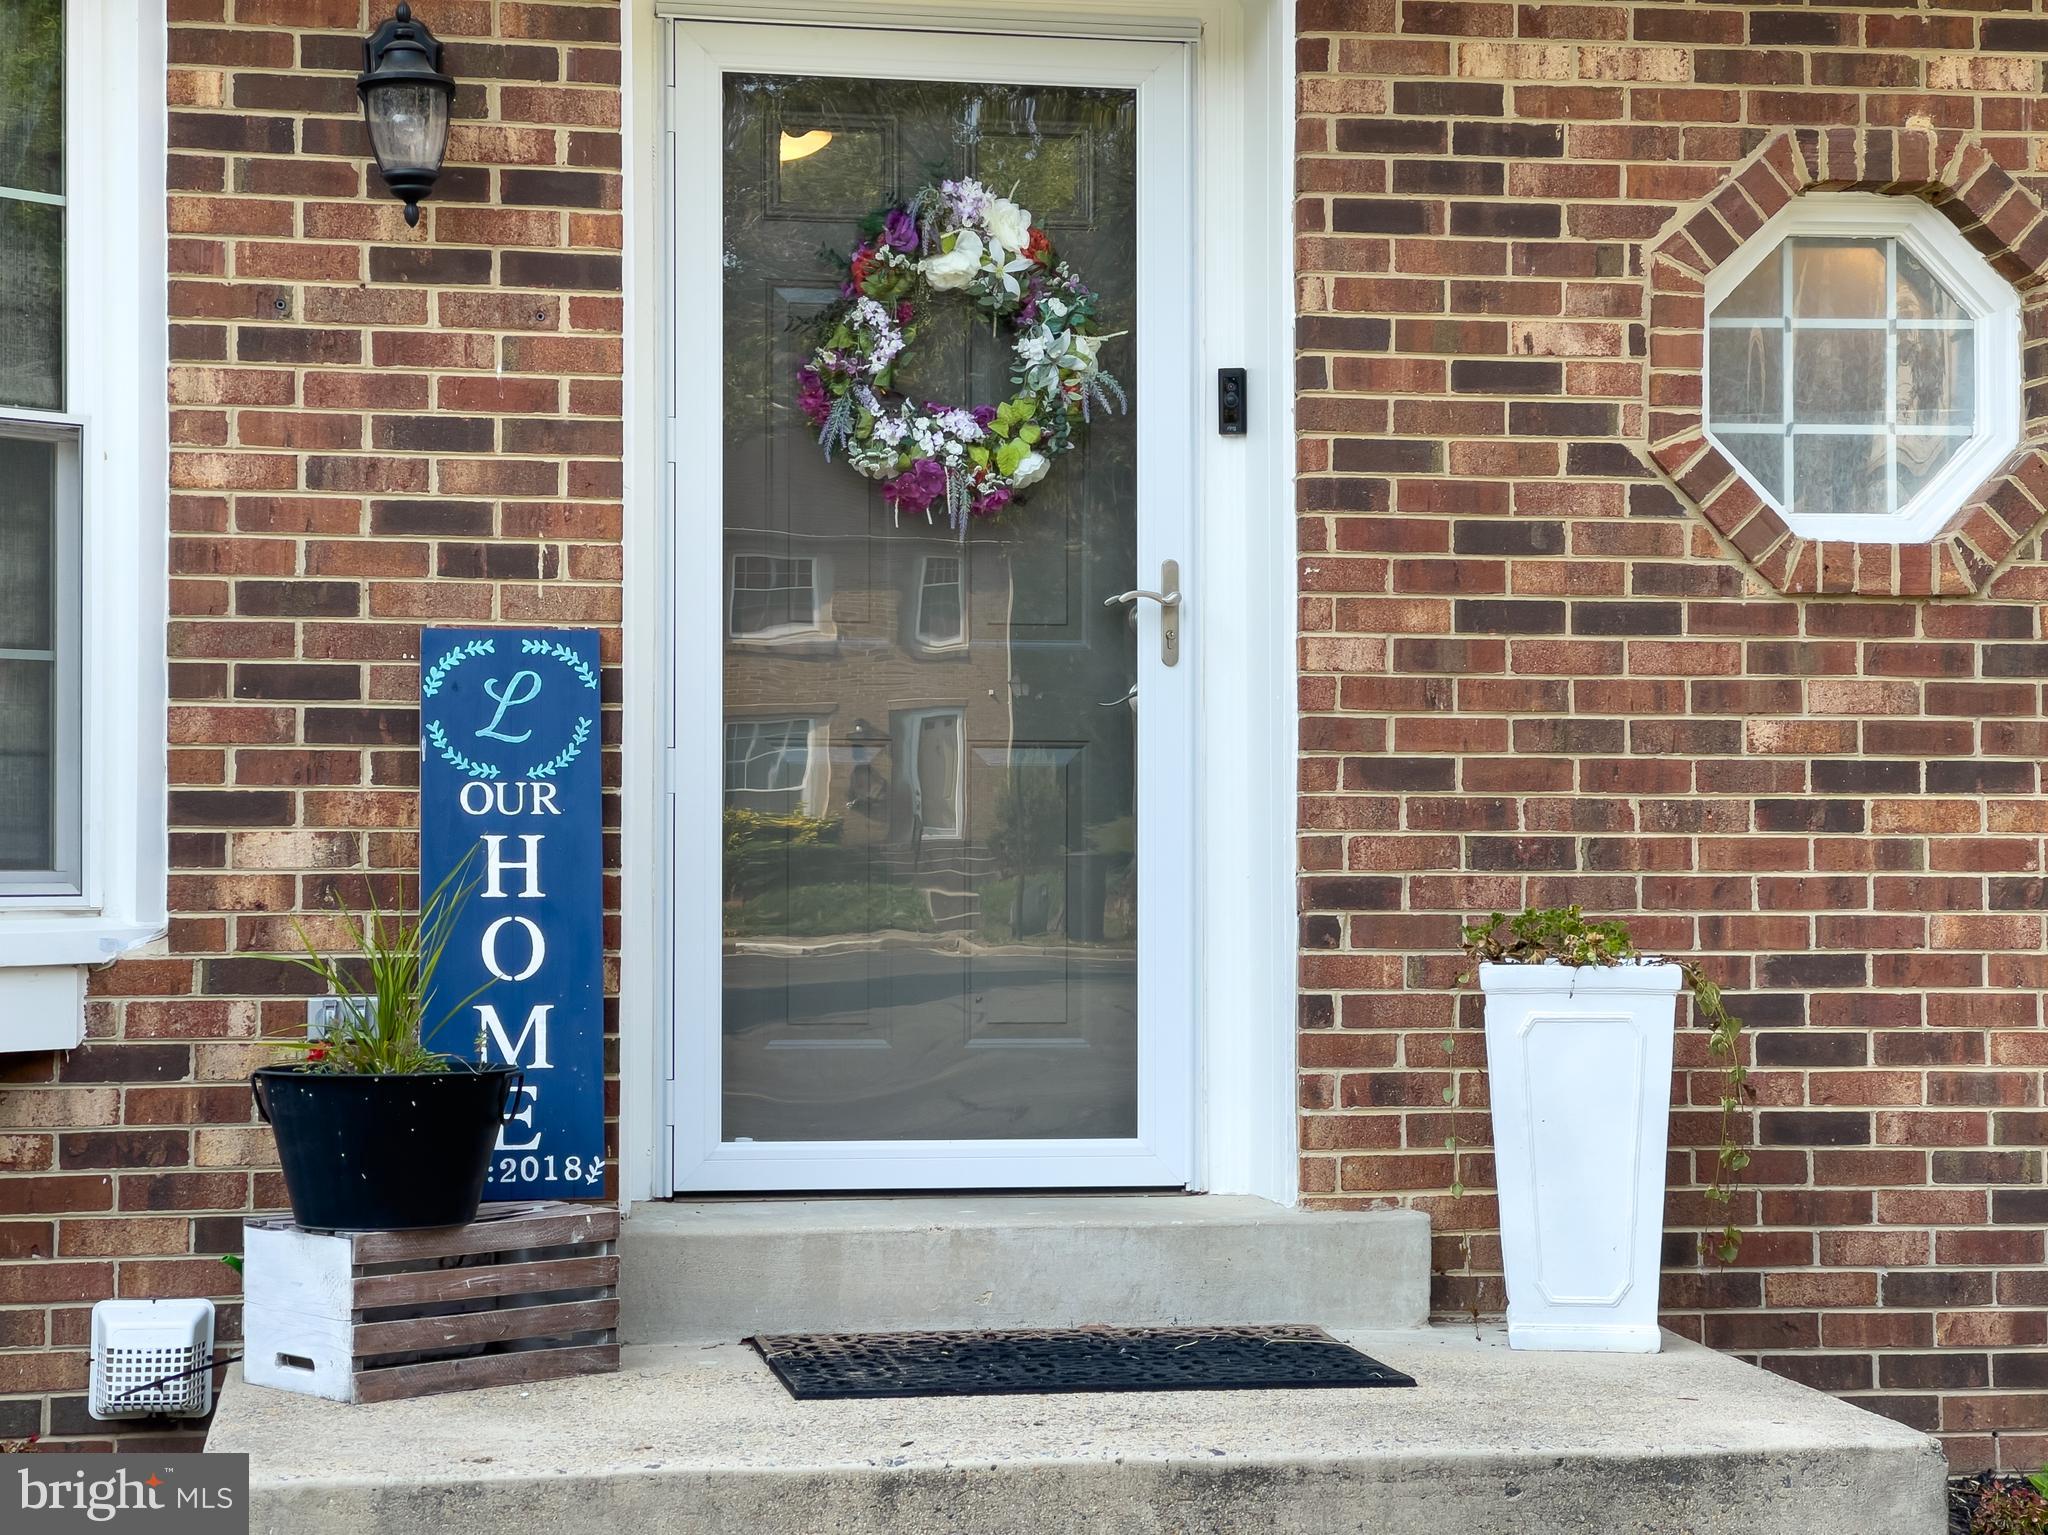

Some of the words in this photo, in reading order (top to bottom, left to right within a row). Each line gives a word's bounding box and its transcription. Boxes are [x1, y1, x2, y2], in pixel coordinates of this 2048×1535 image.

[475, 670, 542, 743] L
[459, 781, 561, 815] OUR
[472, 834, 555, 1151] HOME
